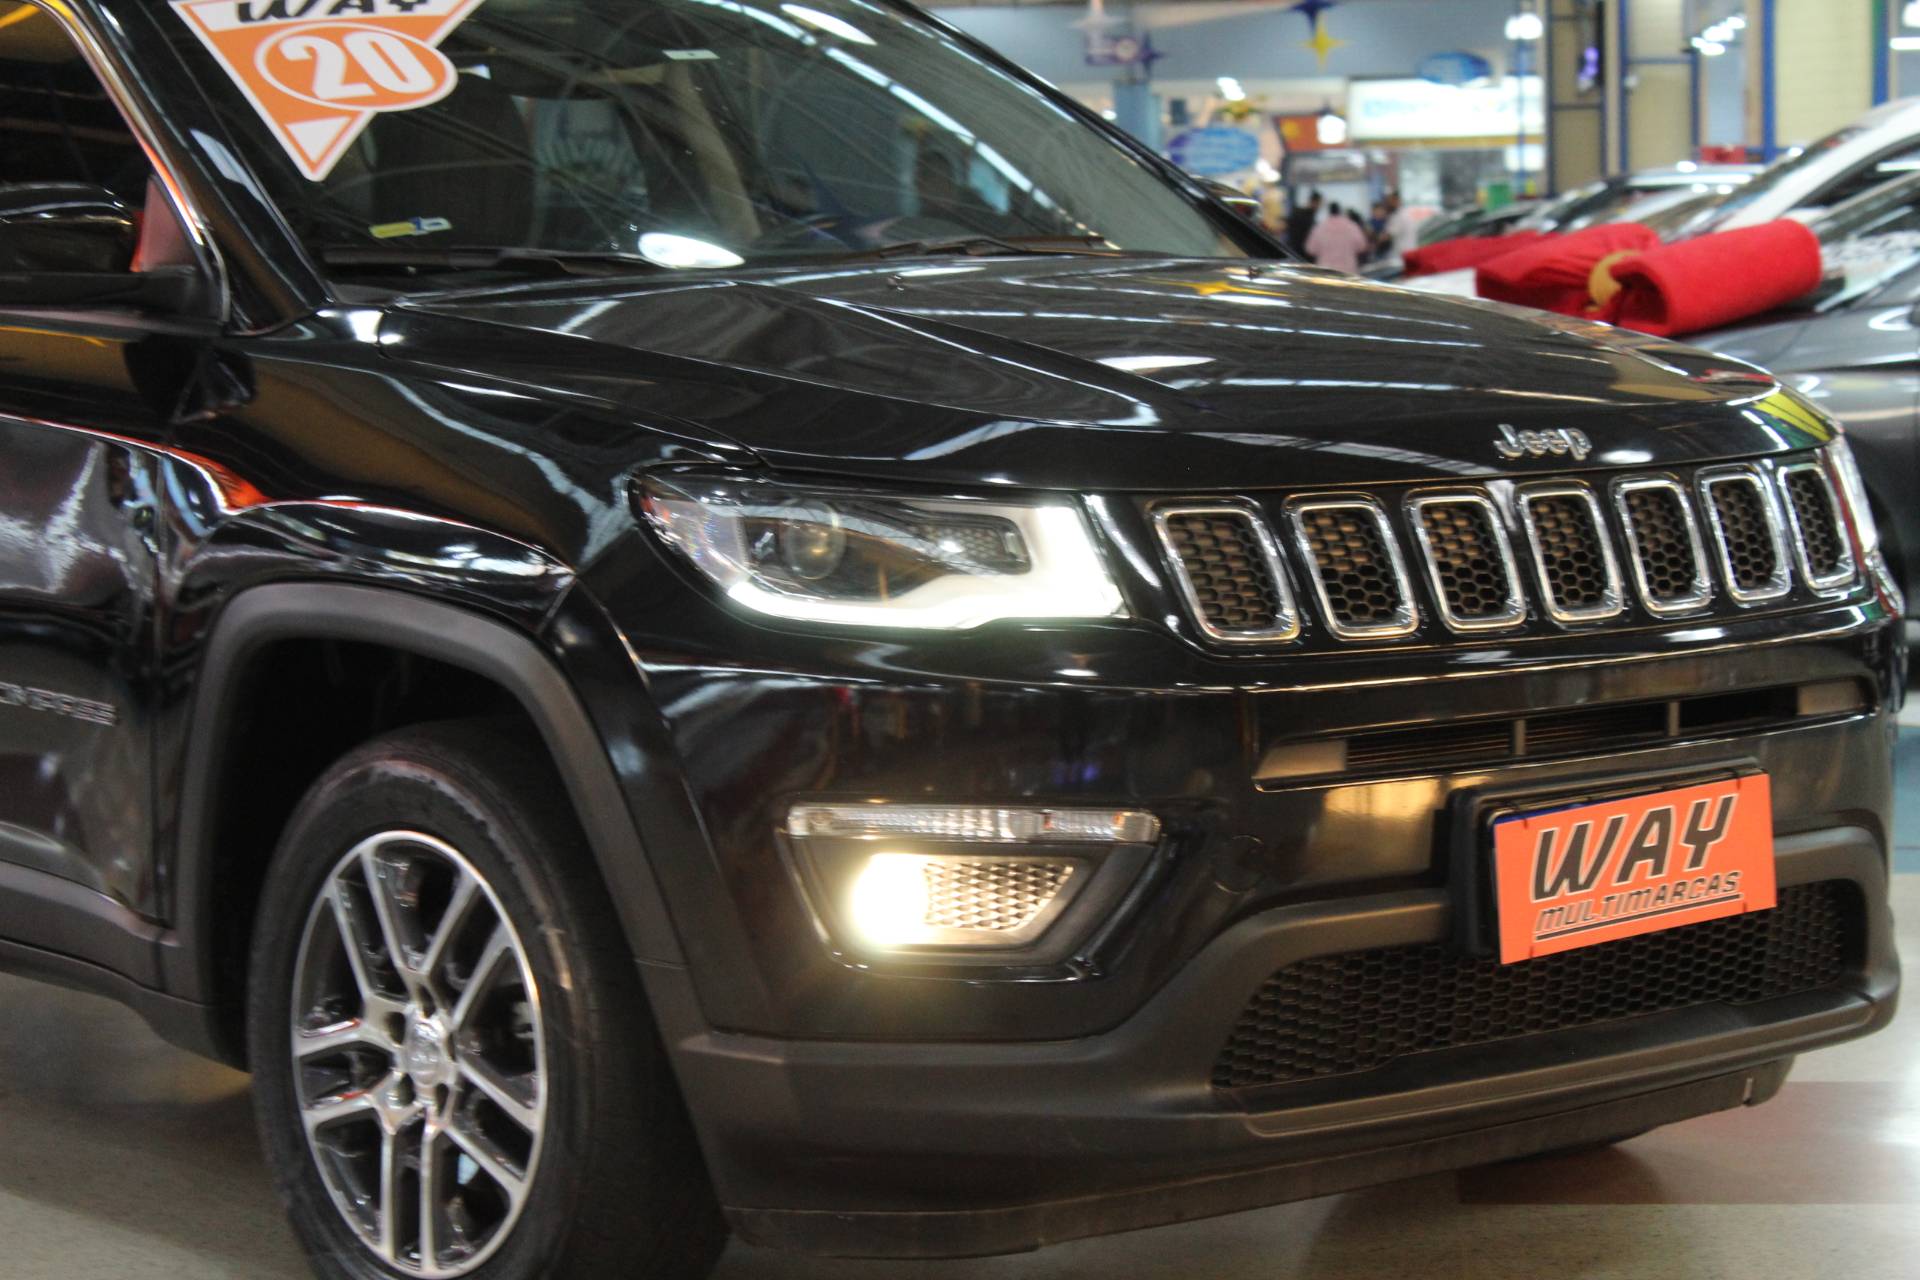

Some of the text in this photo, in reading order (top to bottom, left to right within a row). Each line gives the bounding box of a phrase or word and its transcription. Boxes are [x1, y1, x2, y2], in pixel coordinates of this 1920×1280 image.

[279, 31, 435, 100] 20
[1493, 424, 1592, 460] Jeep
[1531, 793, 1739, 903] WAY
[1534, 870, 1742, 932] MULTIMARCAS
